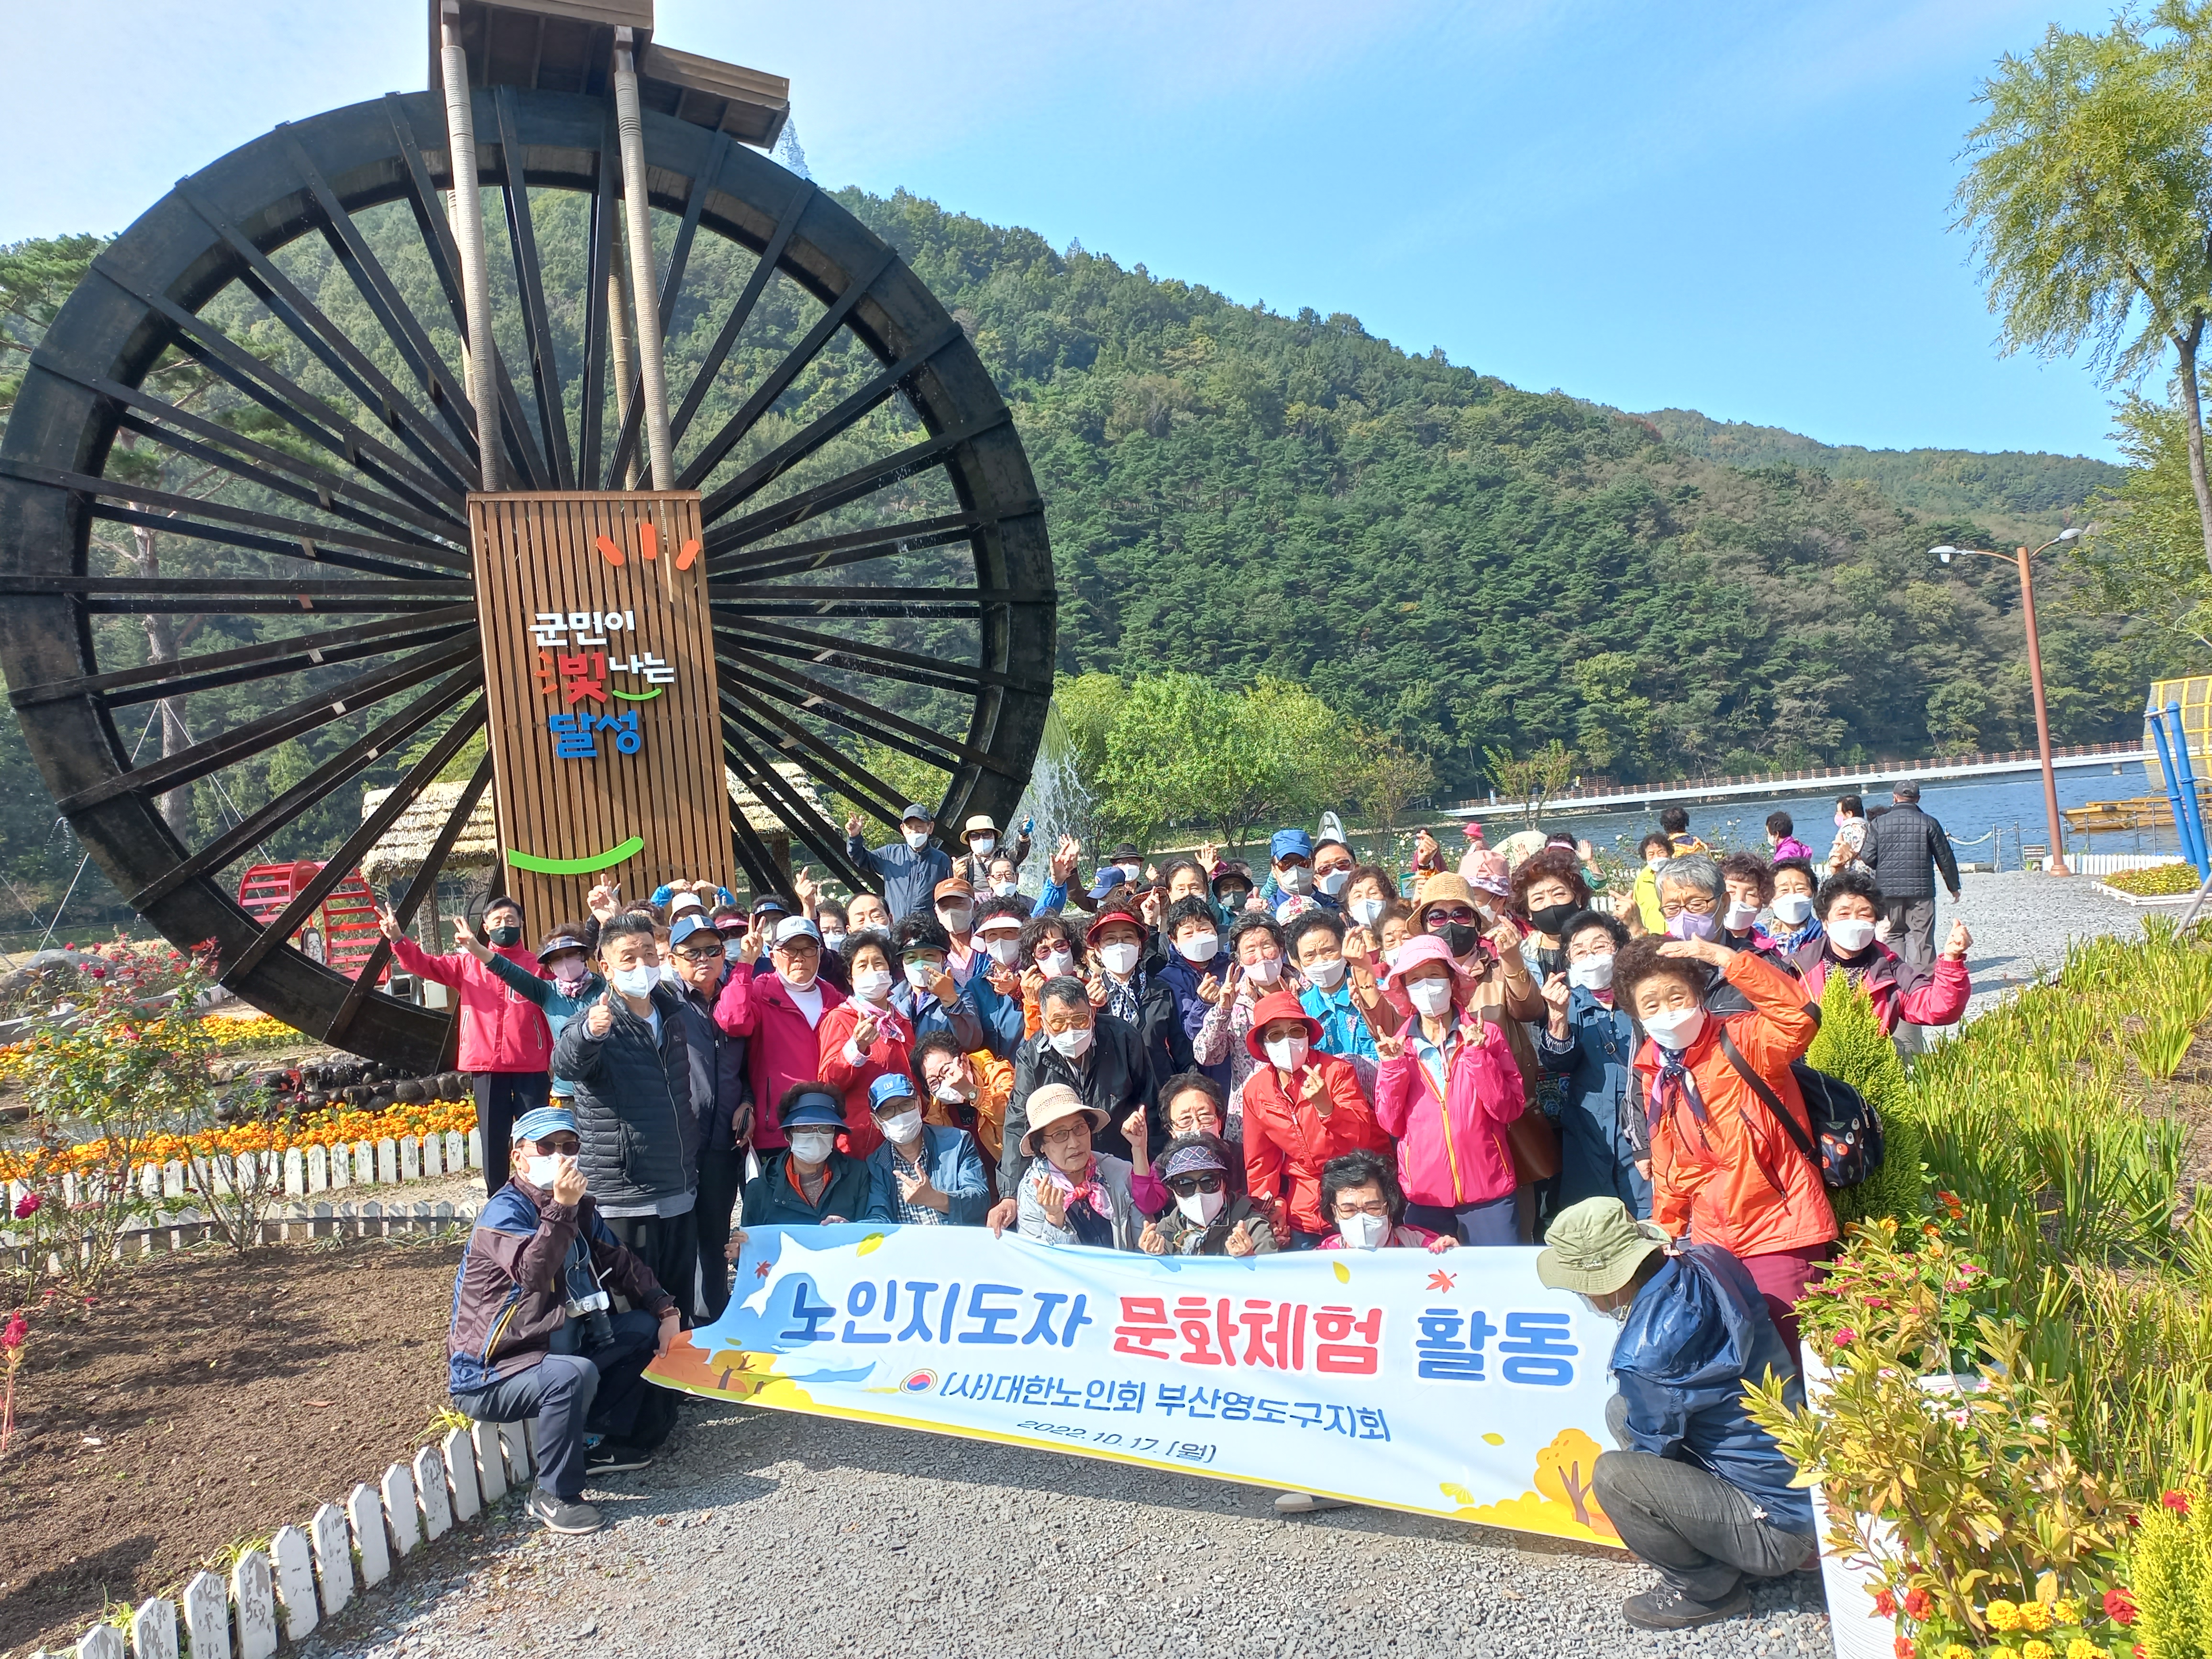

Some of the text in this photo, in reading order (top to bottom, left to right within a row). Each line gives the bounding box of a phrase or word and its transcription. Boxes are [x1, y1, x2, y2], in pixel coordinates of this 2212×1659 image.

[529, 610, 635, 647] 군민이
[559, 652, 675, 704] 빛나는
[550, 710, 641, 759] 달성
[780, 1280, 1579, 1386] 노인지도자 문화체험 활동
[940, 1372, 1391, 1442] (사)대한노인회 부산영도구지회
